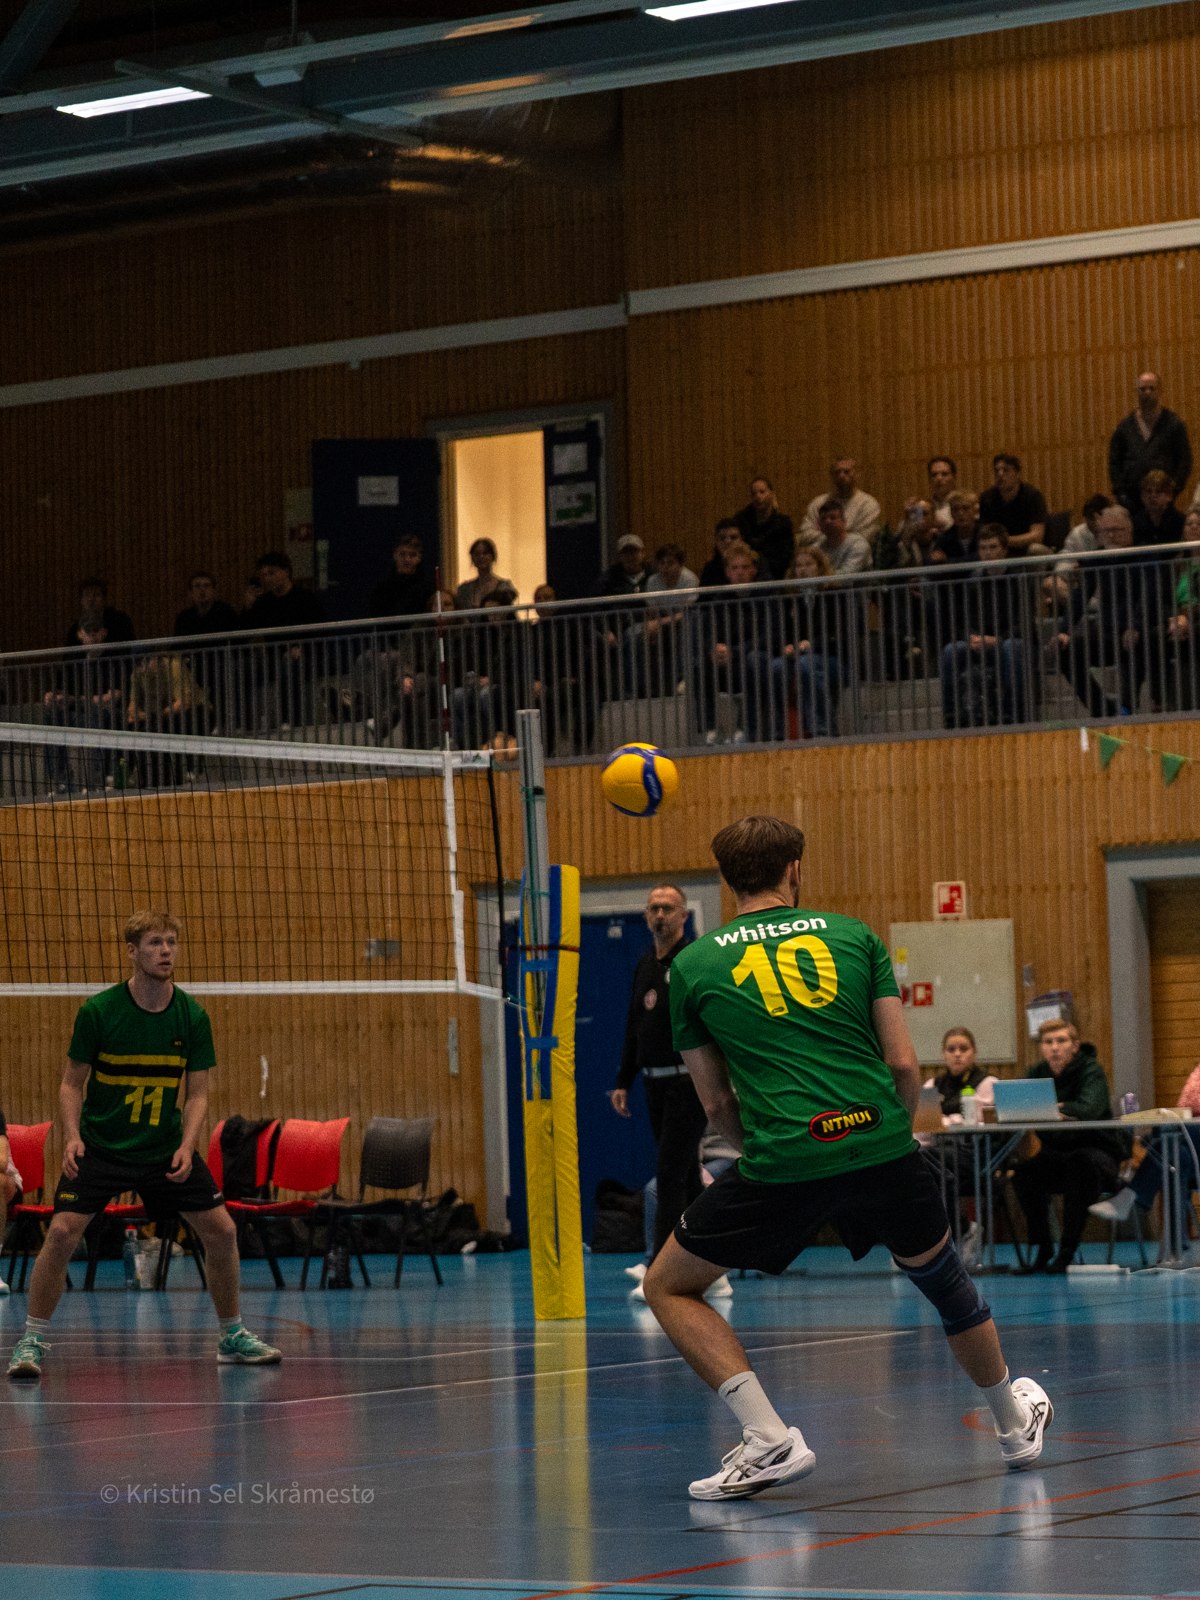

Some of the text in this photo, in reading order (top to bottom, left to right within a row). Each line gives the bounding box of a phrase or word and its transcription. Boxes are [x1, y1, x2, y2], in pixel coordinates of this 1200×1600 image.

[714, 917, 828, 947] whitson
[731, 934, 838, 1018] 10
[125, 1086, 164, 1127] 11
[821, 1110, 872, 1133] NTNUI
